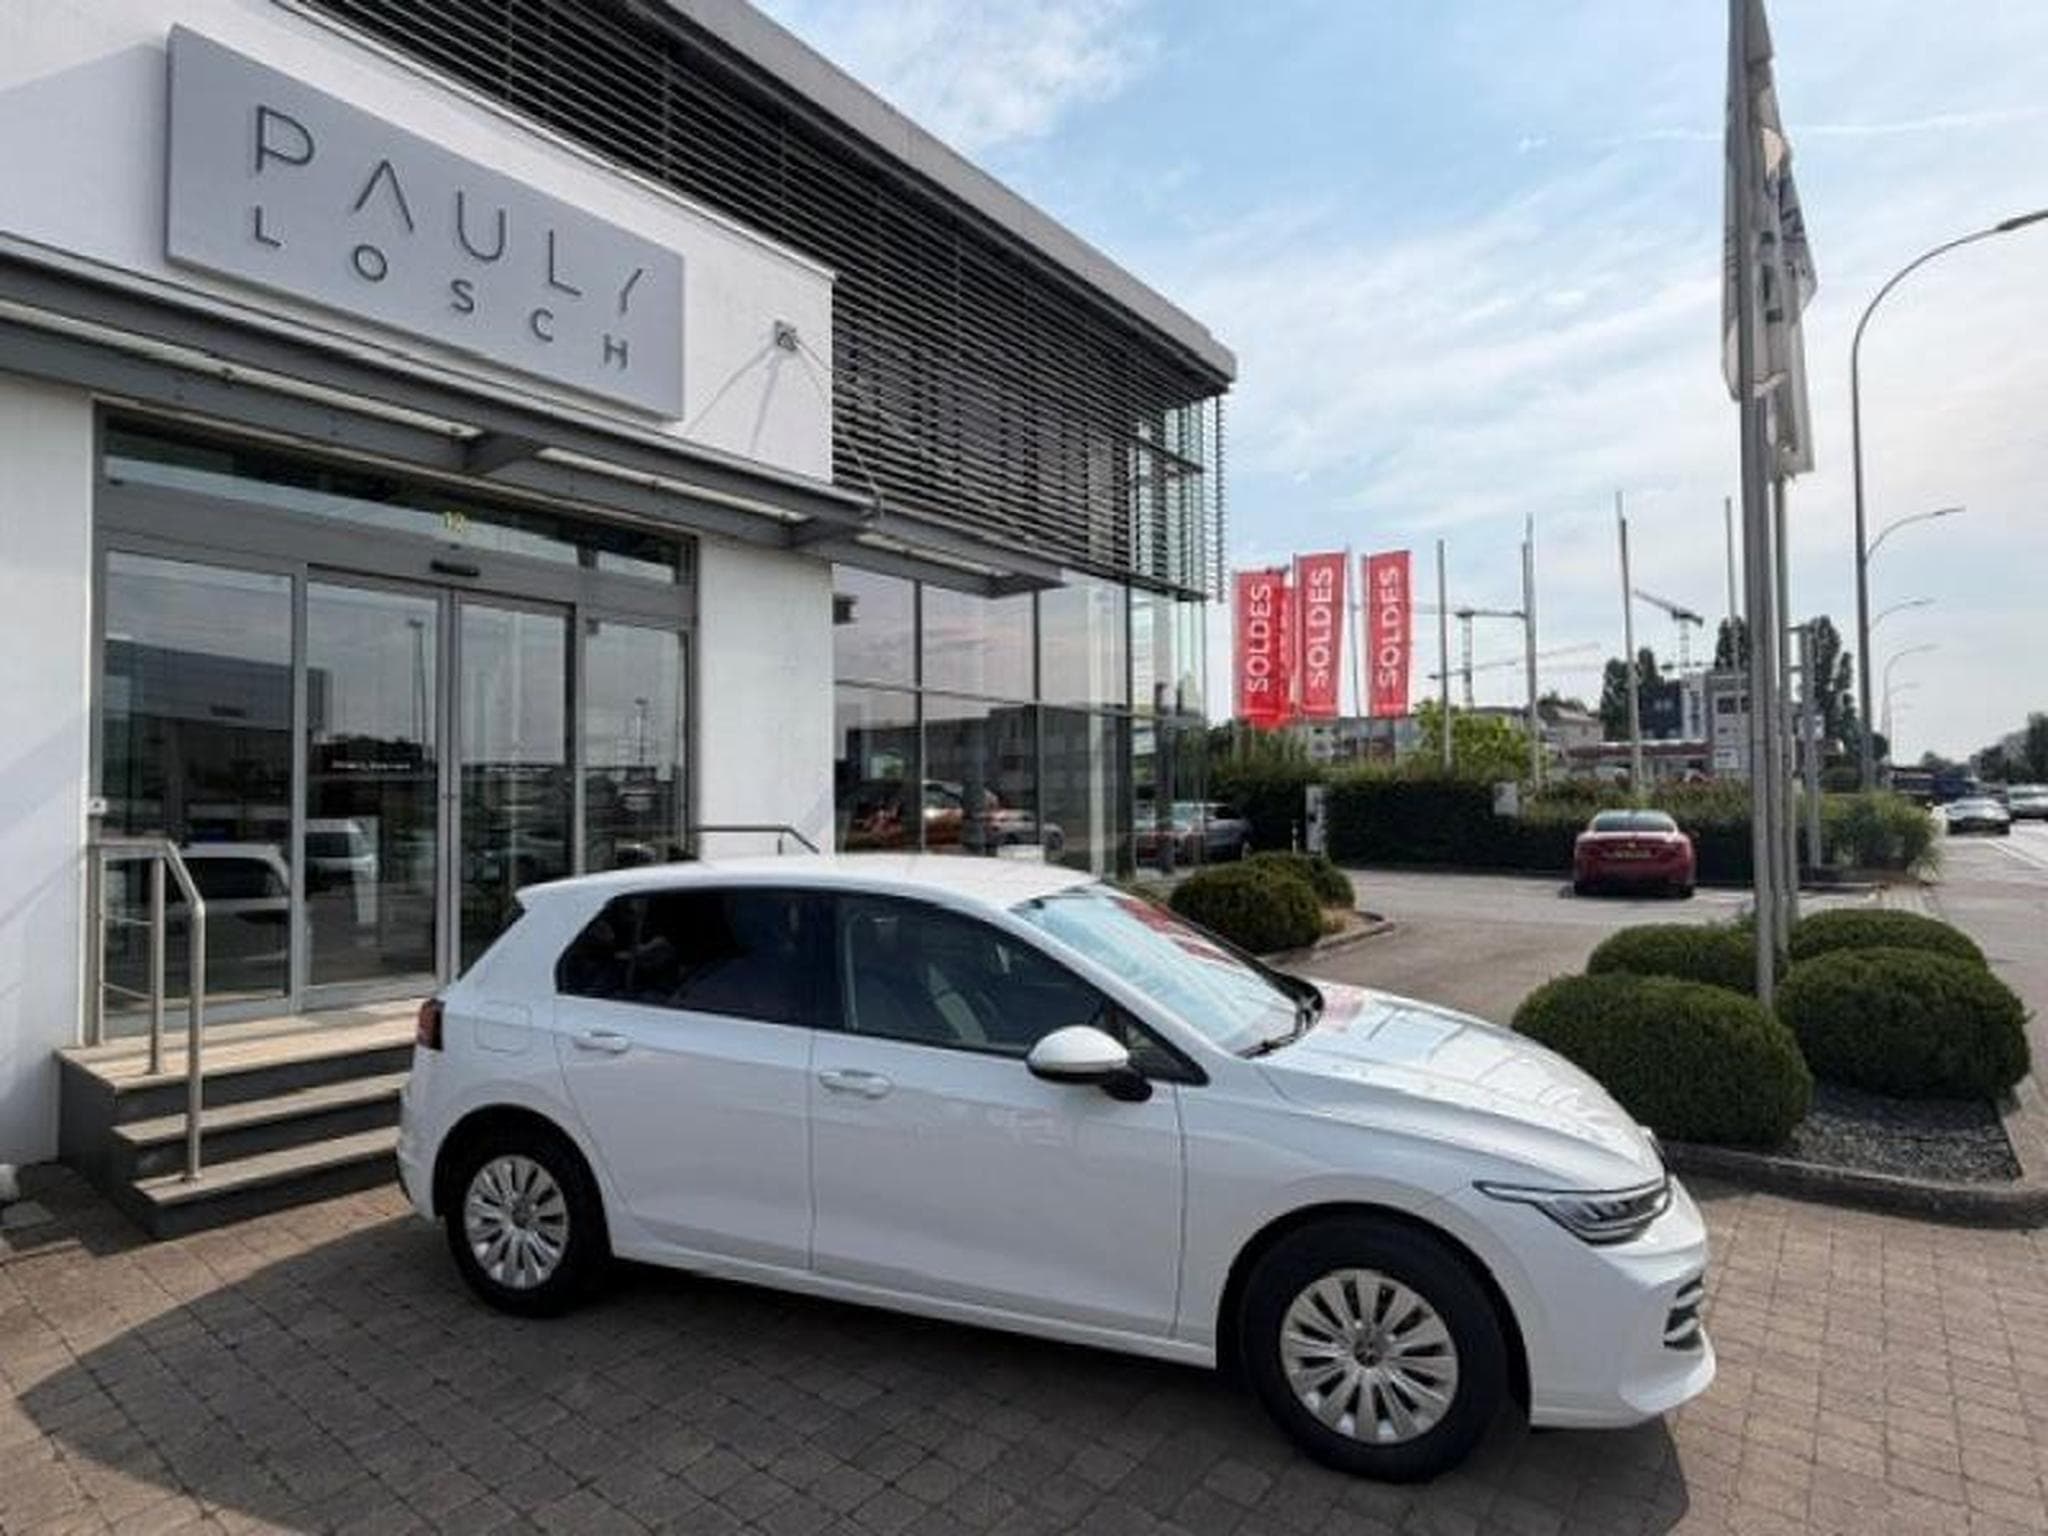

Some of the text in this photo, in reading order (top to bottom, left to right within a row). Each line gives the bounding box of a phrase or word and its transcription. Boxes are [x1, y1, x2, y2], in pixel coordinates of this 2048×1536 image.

[254, 205, 630, 370] LOSCH
[1246, 583, 1272, 693] SOLDES
[1307, 566, 1334, 688] SOLDES
[1378, 565, 1401, 688] SOLDES
